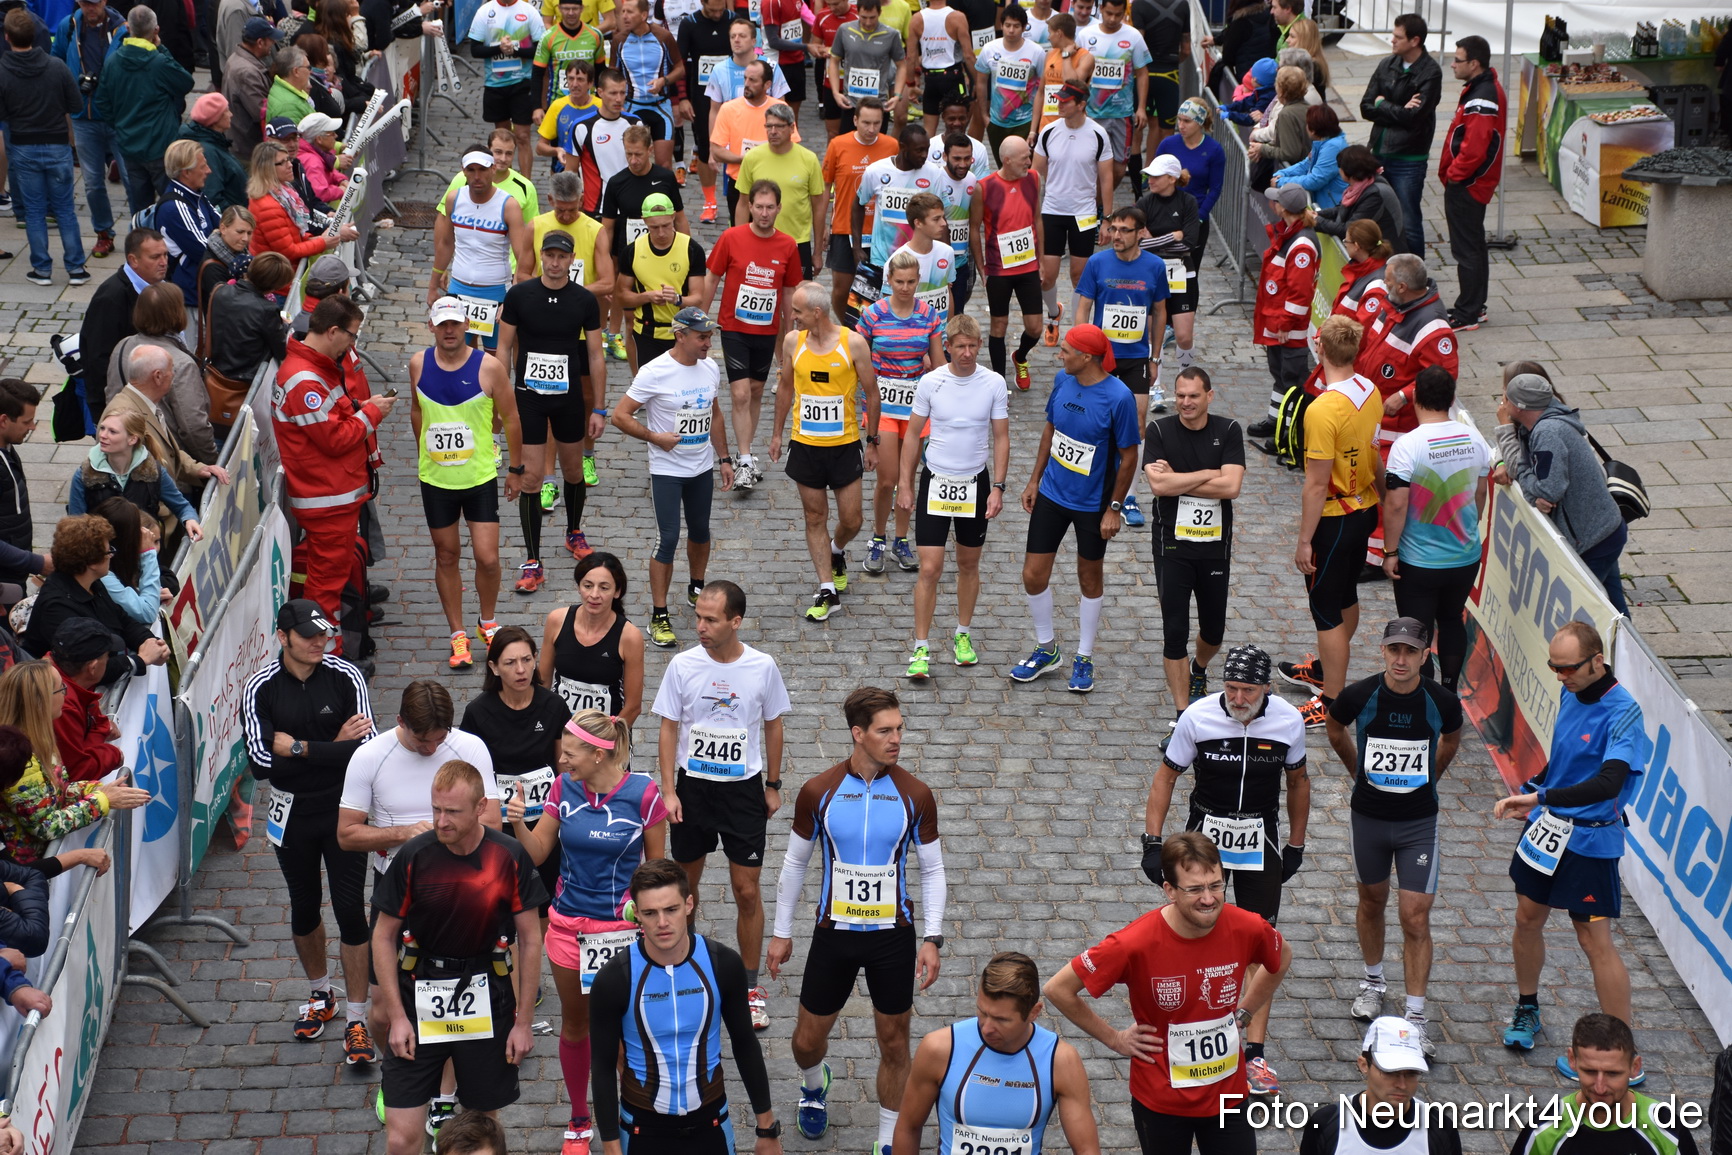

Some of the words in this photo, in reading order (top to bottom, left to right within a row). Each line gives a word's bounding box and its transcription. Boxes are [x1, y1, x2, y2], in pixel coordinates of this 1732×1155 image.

[555, 50, 594, 60] BOCK
[999, 65, 1027, 80] 3083
[1095, 65, 1121, 78] 3084
[851, 74, 877, 88] 2617
[886, 195, 909, 210] 308
[1601, 190, 1649, 219] Lammsb
[950, 227, 968, 241] 086
[1007, 236, 1029, 254] 189
[740, 294, 773, 312] 2676
[464, 304, 488, 321] 145
[746, 312, 764, 321] Martin
[469, 322, 480, 330] oby
[1111, 314, 1138, 330] 206
[529, 362, 565, 380] 2533
[533, 381, 560, 390] Christian
[893, 381, 912, 390] Neumarkt
[880, 386, 915, 405] 3016
[803, 404, 839, 421] 3011
[678, 416, 711, 434] 2018
[434, 432, 464, 450] 378
[443, 452, 458, 460] Andi
[1057, 441, 1085, 465] 537
[1428, 446, 1475, 461] NeuerMarkt
[938, 484, 968, 501] 383
[940, 503, 963, 513] Jürgen
[1180, 499, 1197, 507] PARTL
[1192, 508, 1214, 526] 32
[1185, 528, 1215, 538] Wolfgang
[574, 685, 602, 695] Neumarkt
[562, 689, 606, 713] 2703
[691, 728, 708, 738] PARTL
[709, 732, 738, 741] Neumarkt
[693, 738, 742, 762] 2446
[1367, 742, 1389, 750] PARTL
[1204, 751, 1242, 762] TEAM
[1371, 751, 1423, 772] 2374
[700, 763, 731, 775] Michael
[498, 778, 516, 786] PARTL
[1383, 776, 1409, 786] Andre
[1205, 816, 1226, 828] PARTL
[1226, 823, 1256, 831] Neumarkt
[588, 830, 611, 839] MCM
[1209, 827, 1259, 851] 3044
[834, 866, 854, 877] PARTL
[854, 870, 886, 878] Neumarkt
[844, 879, 882, 902] 131
[845, 906, 880, 917] Andreas
[602, 935, 634, 945] Neumarkt
[1203, 969, 1235, 979] STADTLAUF
[1204, 962, 1239, 974] NEUMARKTER
[417, 985, 441, 993] PARTL
[1155, 987, 1183, 995] WIEDER
[1156, 981, 1181, 989] IMMER
[1158, 993, 1181, 1002] NEU
[431, 991, 477, 1019] 342
[445, 1023, 465, 1033] Nils
[1169, 1028, 1194, 1038] PARTL
[1195, 1023, 1228, 1036] Neumarkt
[1184, 1031, 1229, 1063] 160
[1189, 1061, 1226, 1078] Michael
[954, 1128, 980, 1141] PARTL
[981, 1135, 1020, 1144] Neumarkt
